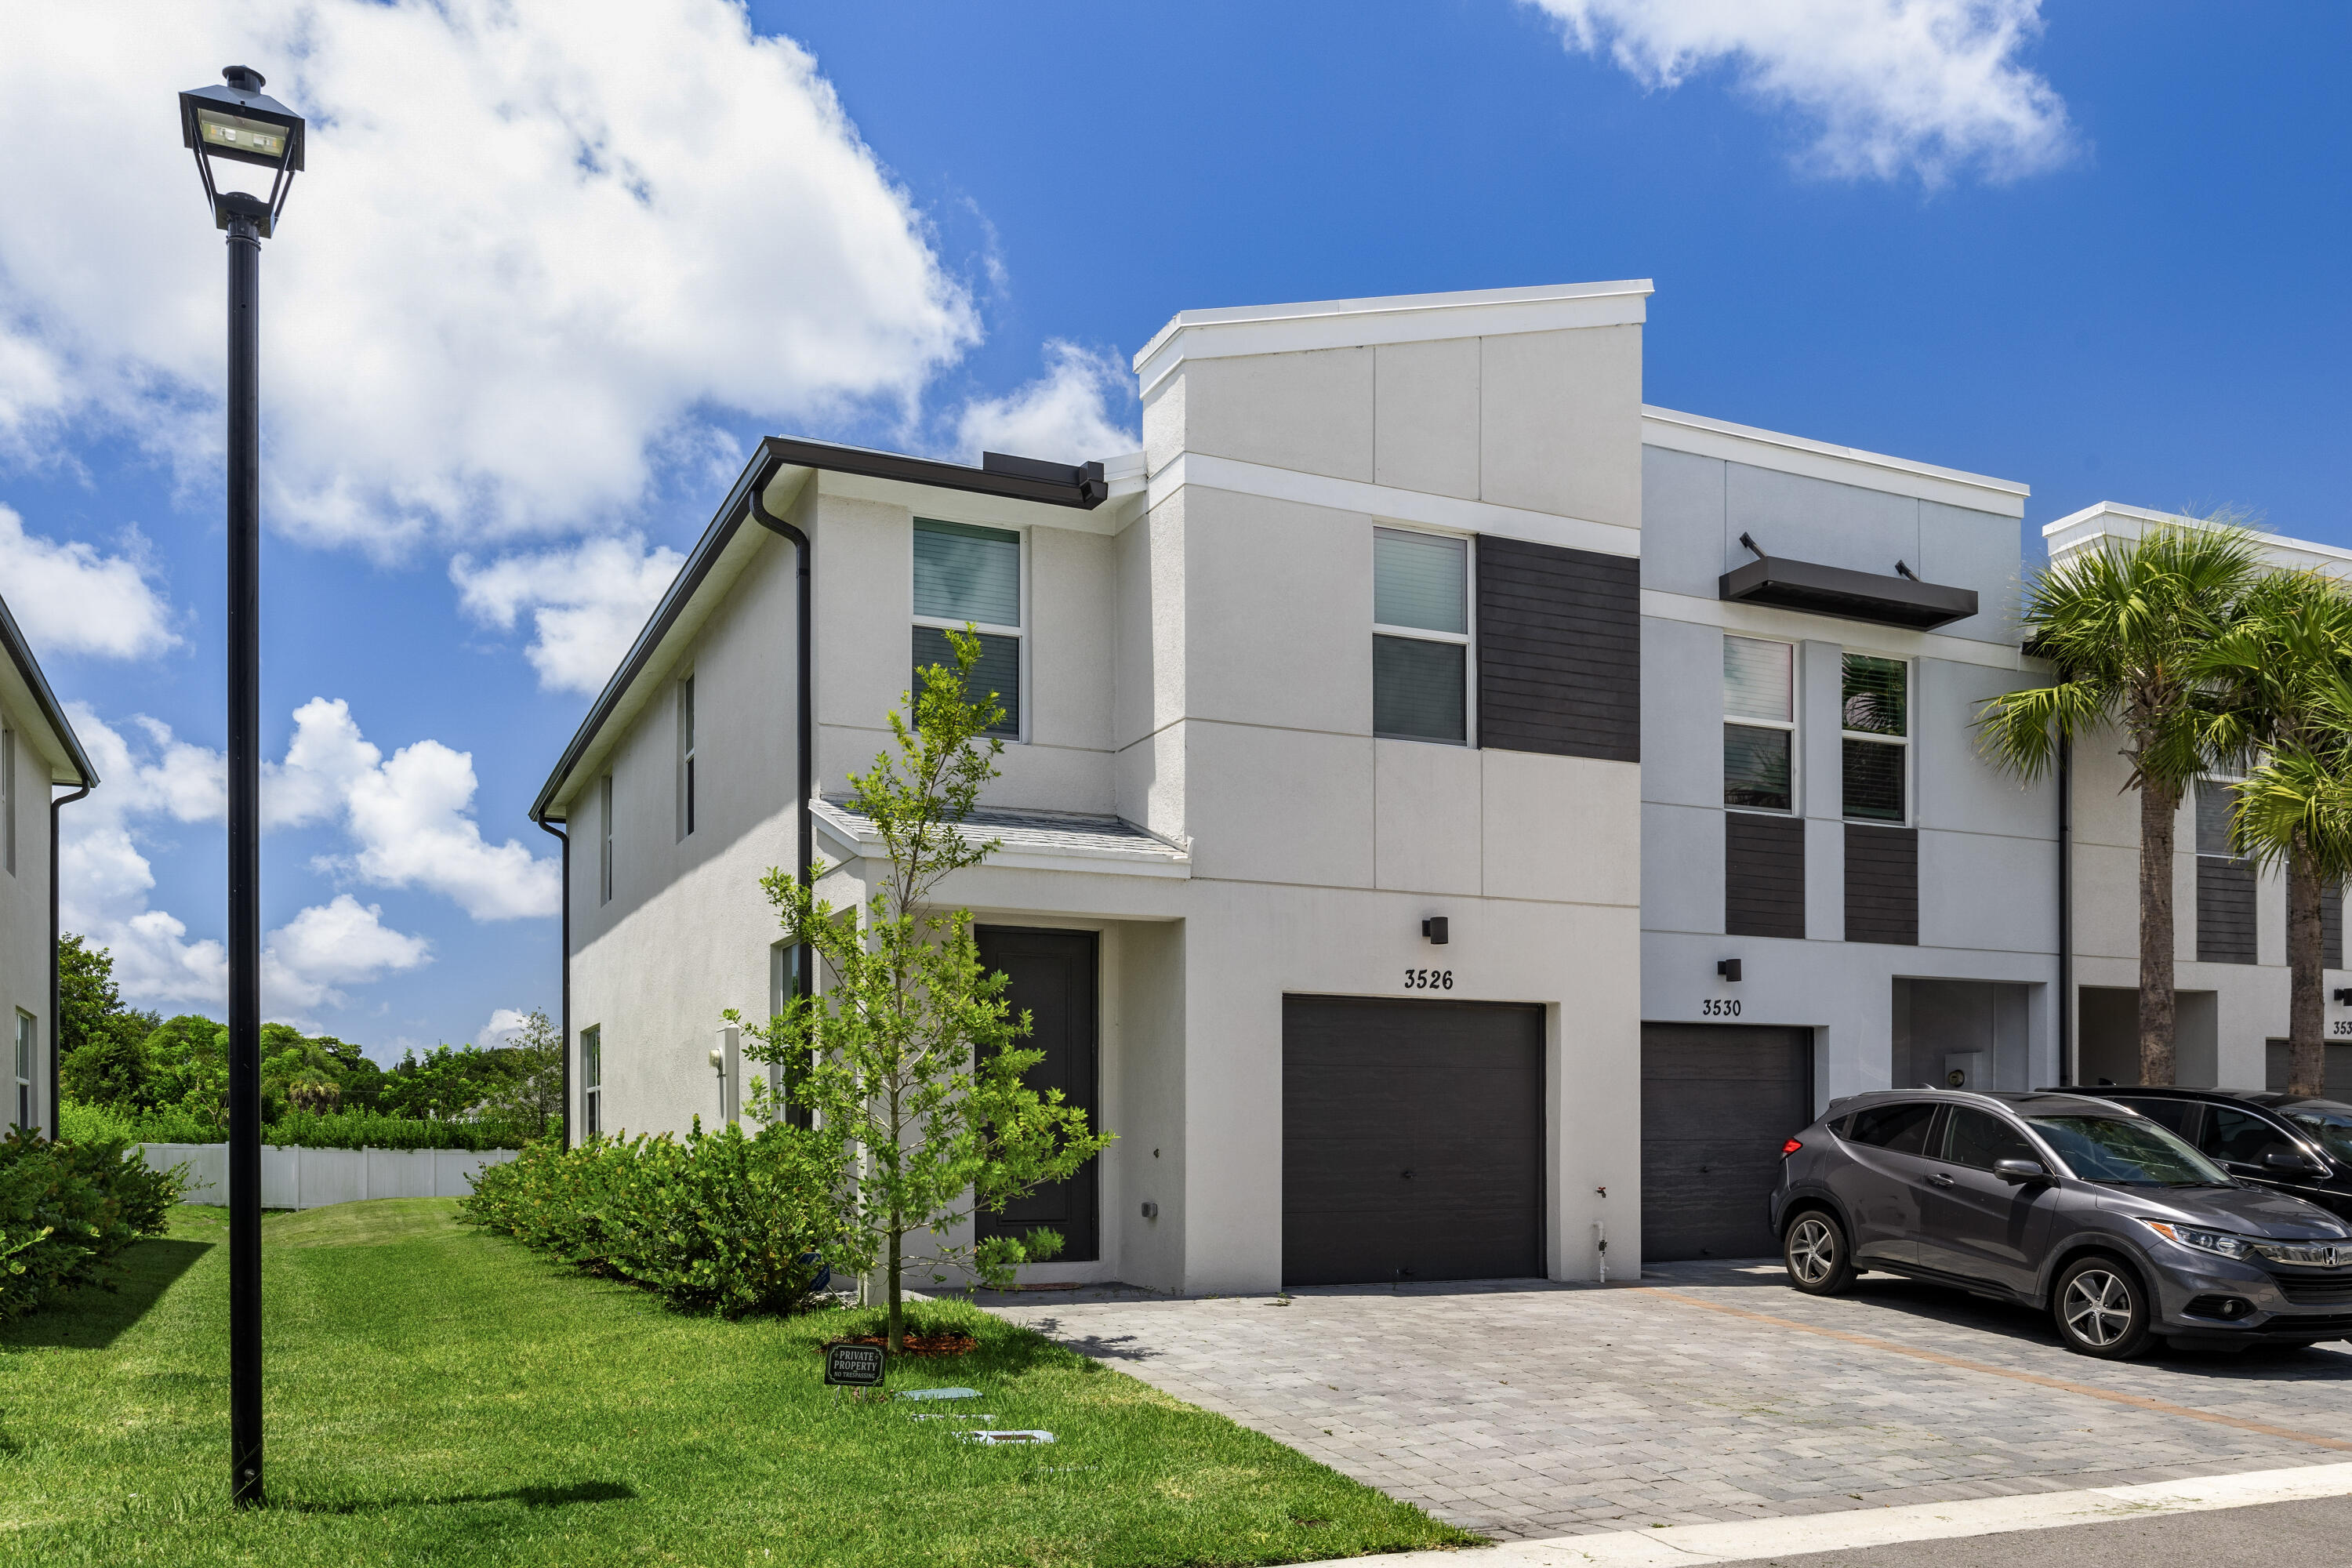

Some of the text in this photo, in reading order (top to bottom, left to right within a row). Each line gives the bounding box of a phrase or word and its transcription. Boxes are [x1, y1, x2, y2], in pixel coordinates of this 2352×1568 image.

[1404, 968, 1454, 990] 3526
[1703, 999, 1741, 1017] 3530
[839, 1350, 874, 1361] PRIVATE
[833, 1360, 878, 1371] PROPERTY
